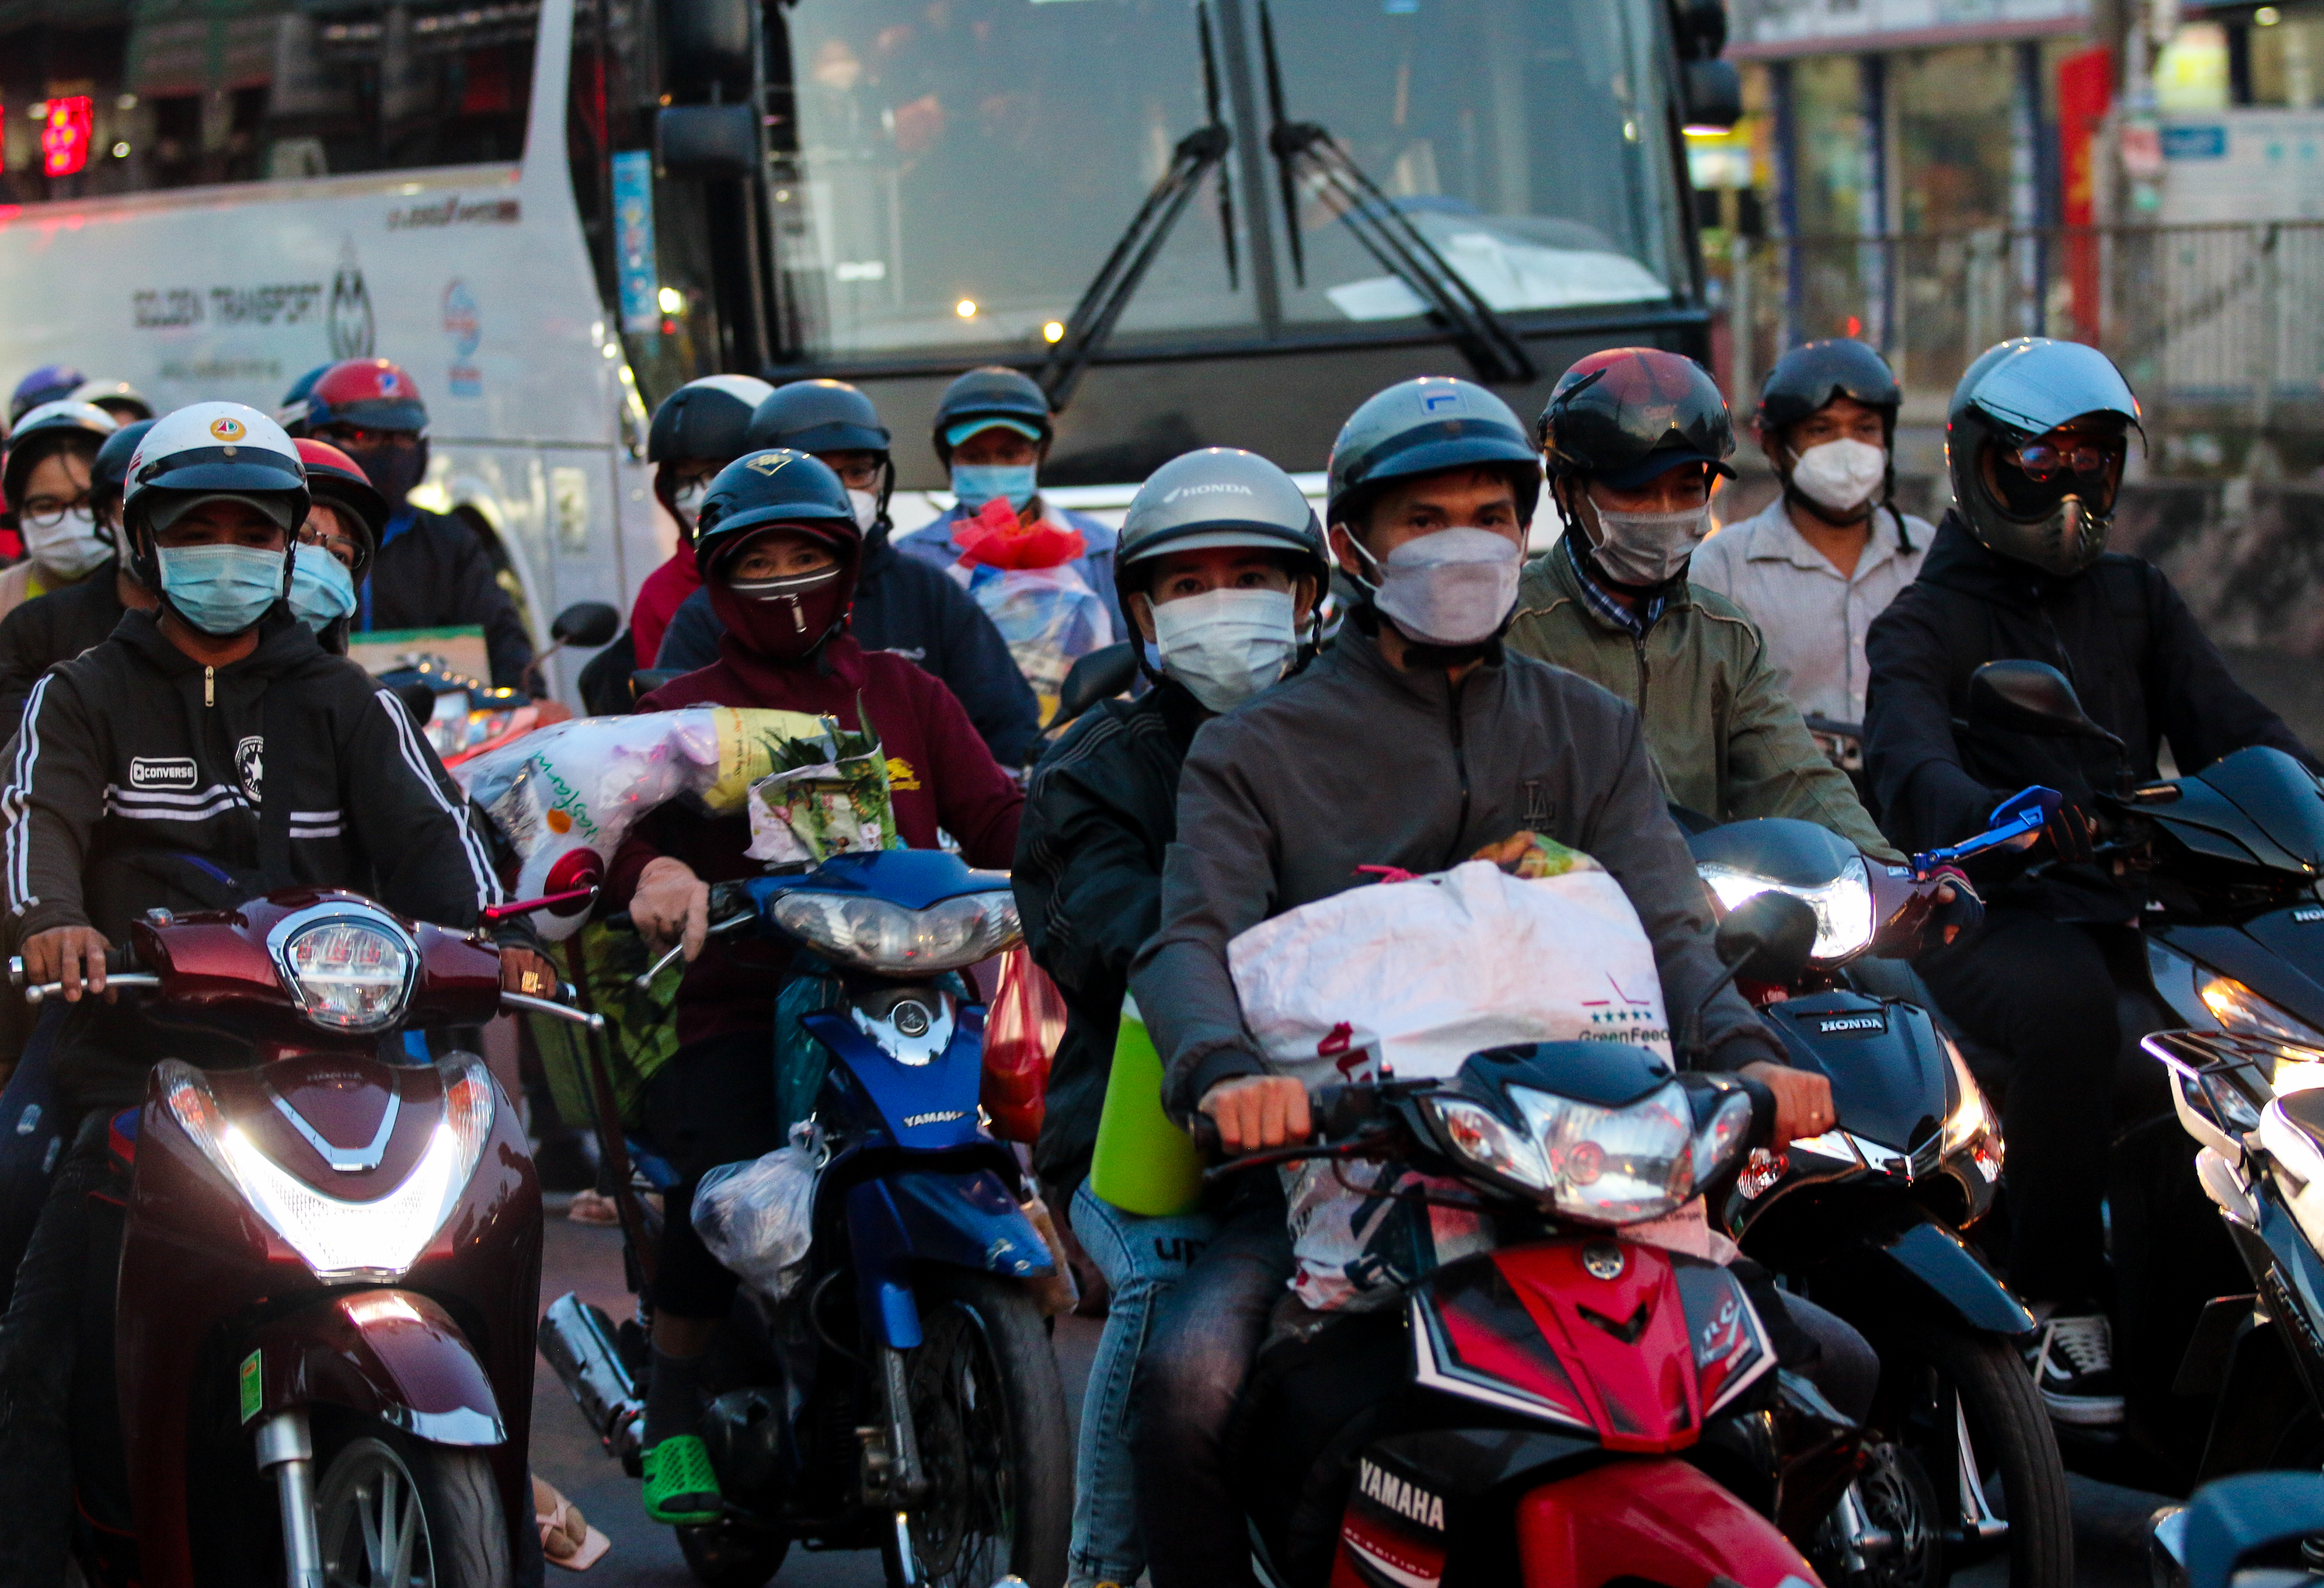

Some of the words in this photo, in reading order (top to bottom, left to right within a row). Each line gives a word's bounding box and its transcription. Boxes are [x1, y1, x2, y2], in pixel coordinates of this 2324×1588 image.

[1182, 484, 1254, 498] HONDA
[145, 766, 194, 779] CONVERSE
[1820, 1018, 1883, 1032] HONDA
[1359, 1457, 1445, 1531] YAMAHA
